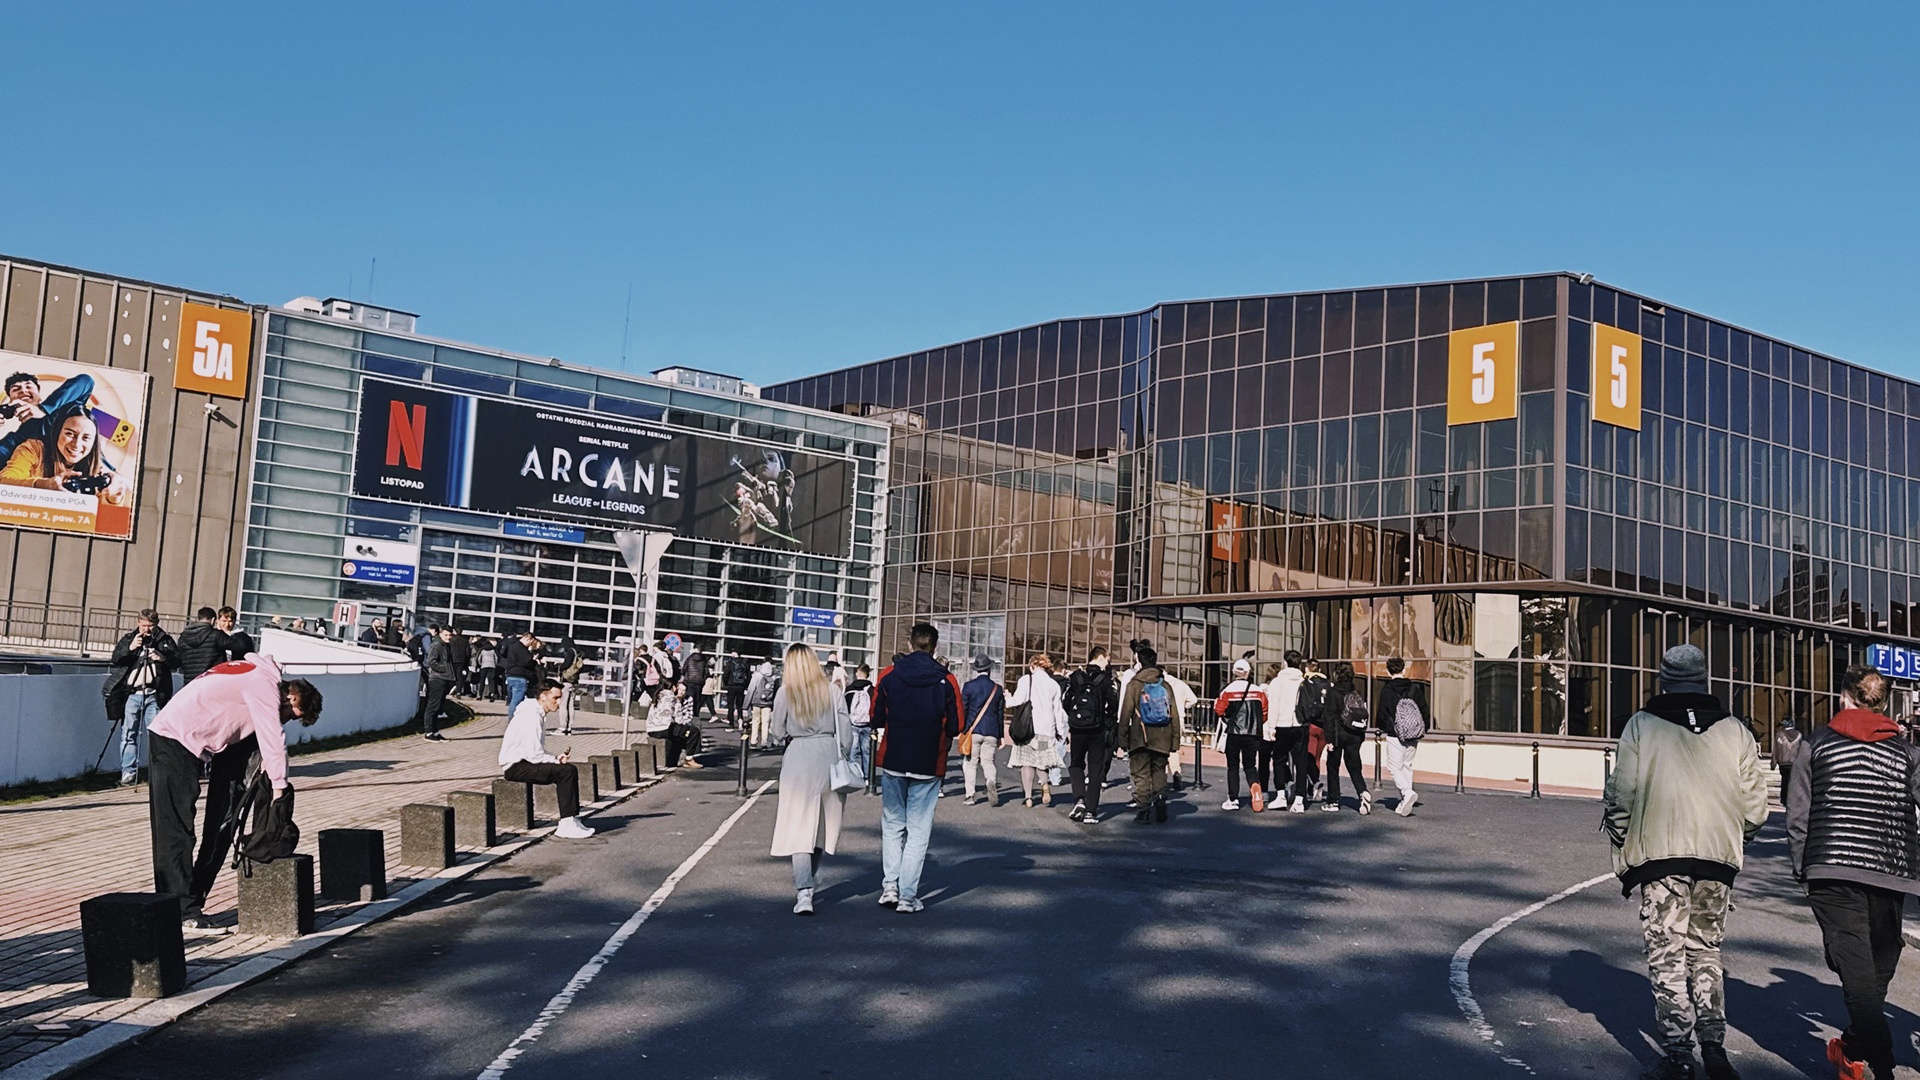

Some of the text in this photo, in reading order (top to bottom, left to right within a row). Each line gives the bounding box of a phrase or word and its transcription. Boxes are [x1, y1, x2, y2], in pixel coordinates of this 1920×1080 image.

[192, 320, 234, 382] 5A
[1471, 341, 1495, 405] 5
[1611, 344, 1628, 409] 5
[385, 400, 427, 471] N
[536, 412, 672, 440] OSTATNI ROZDZIAŁ NAGRADZANEGO SERIALU
[578, 435, 629, 450] SERIAL NETFLIX
[380, 476, 425, 490] LISTOPAD
[520, 444, 681, 500] ARCANE
[40, 495, 54, 503] nas
[56, 496, 66, 504] na
[68, 497, 87, 506] PGA
[552, 493, 593, 508] LEAGUE
[600, 500, 646, 515] LEGENDS
[0, 507, 28, 518] toisko
[30, 511, 41, 519] nr
[52, 514, 76, 523] paw.
[77, 515, 91, 525] 7A
[340, 606, 350, 622] H
[1879, 650, 1886, 666] F
[1895, 646, 1905, 673] 5
